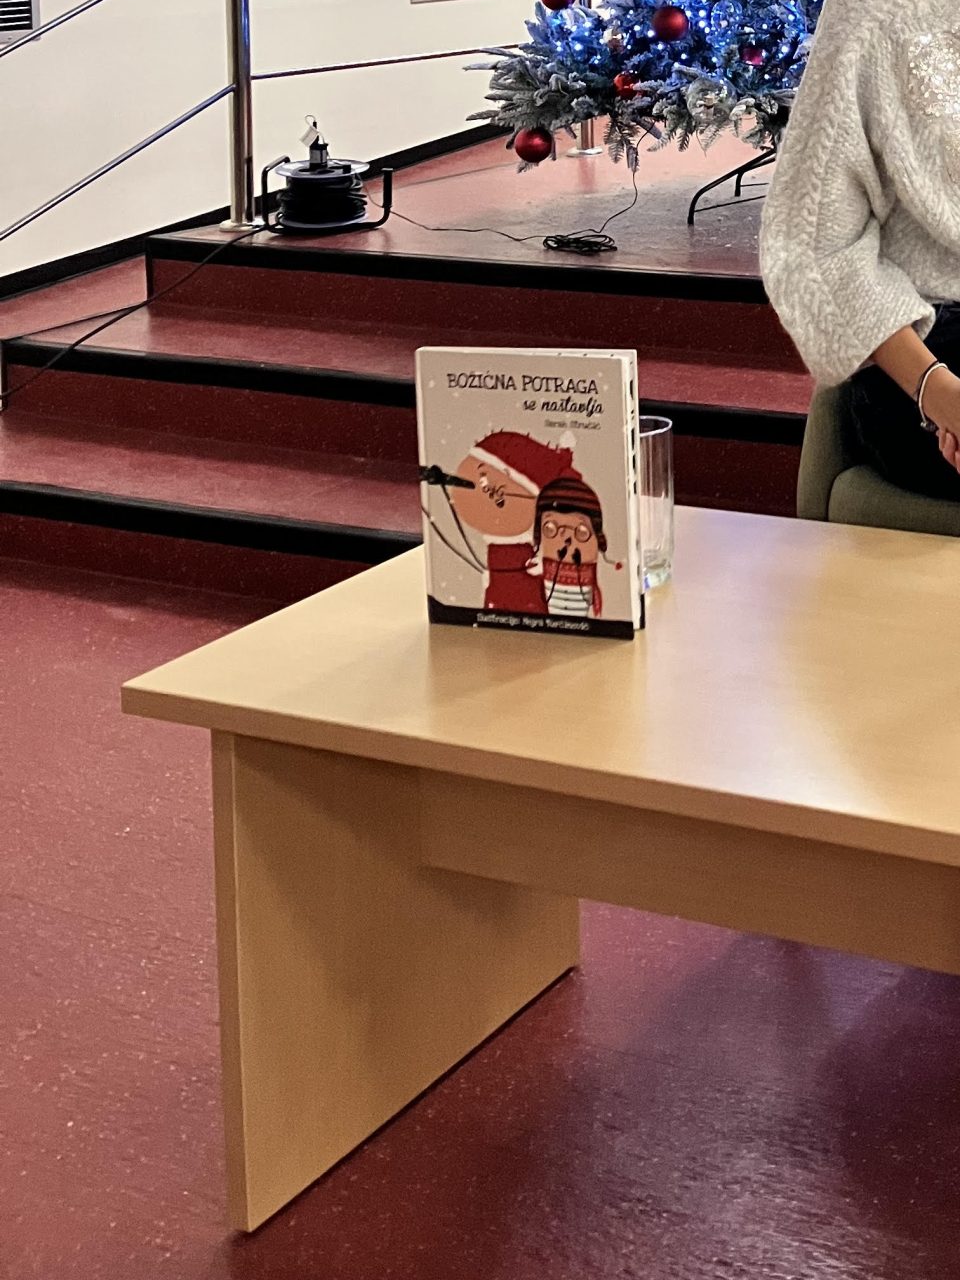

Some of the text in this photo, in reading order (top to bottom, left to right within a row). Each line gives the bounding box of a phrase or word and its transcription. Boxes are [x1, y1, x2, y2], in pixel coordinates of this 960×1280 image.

[522, 375, 599, 395] POTRAGA
[523, 396, 604, 417] se nastavlja
